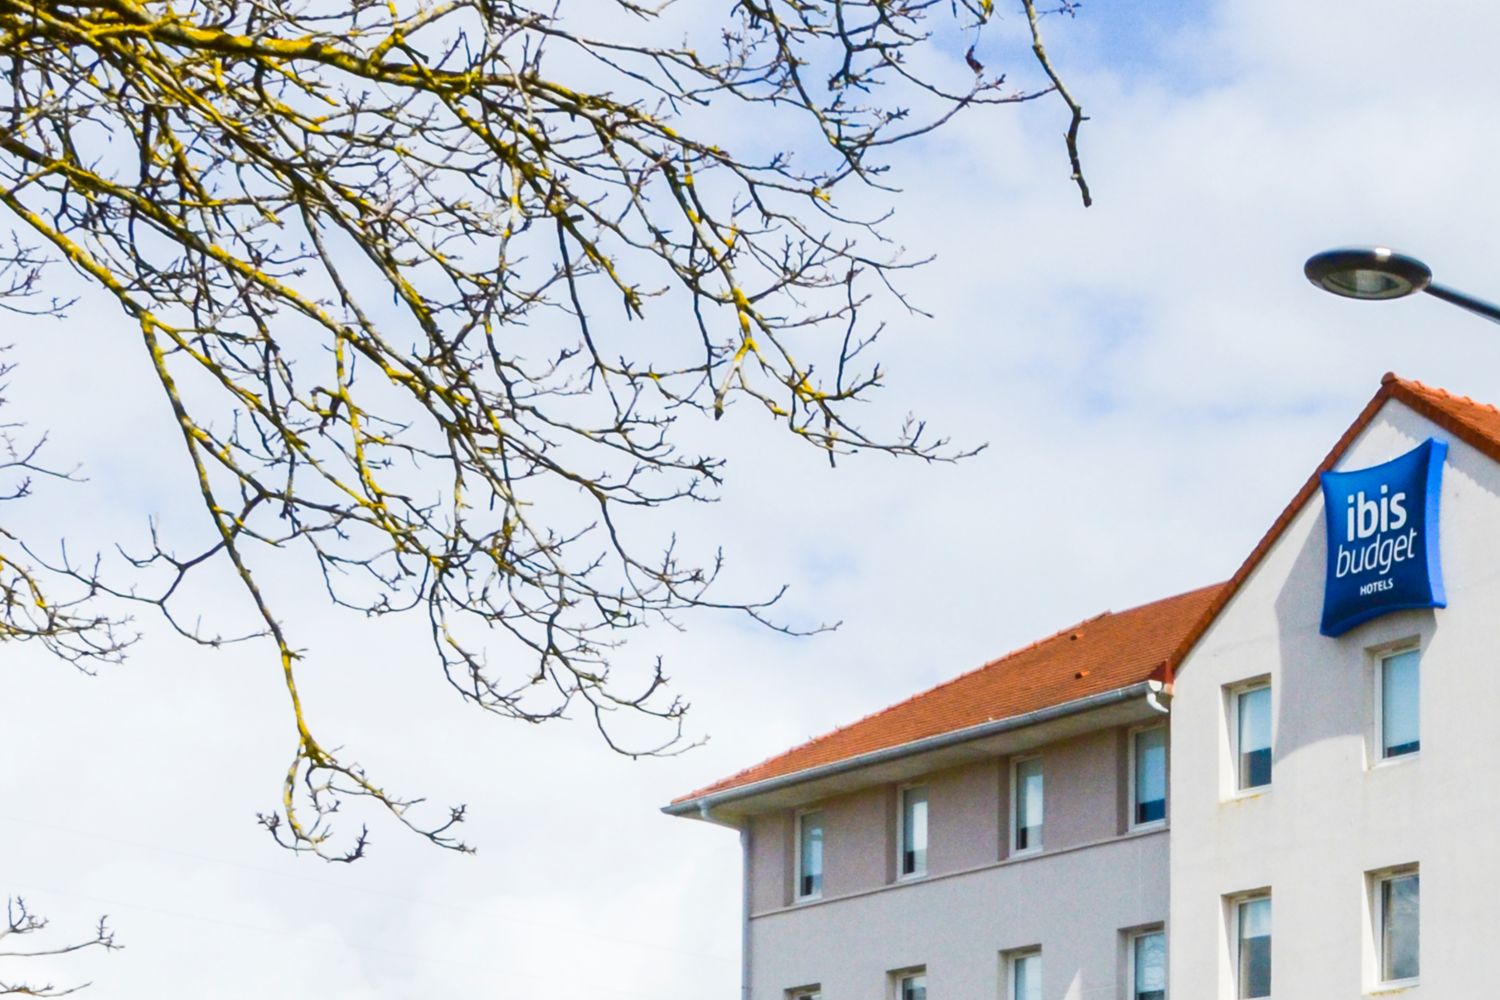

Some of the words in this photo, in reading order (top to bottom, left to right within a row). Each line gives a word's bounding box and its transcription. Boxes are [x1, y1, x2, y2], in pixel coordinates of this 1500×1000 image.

[1346, 484, 1408, 542] ibis
[1335, 527, 1418, 579] budget
[1359, 577, 1394, 597] HOTELS
